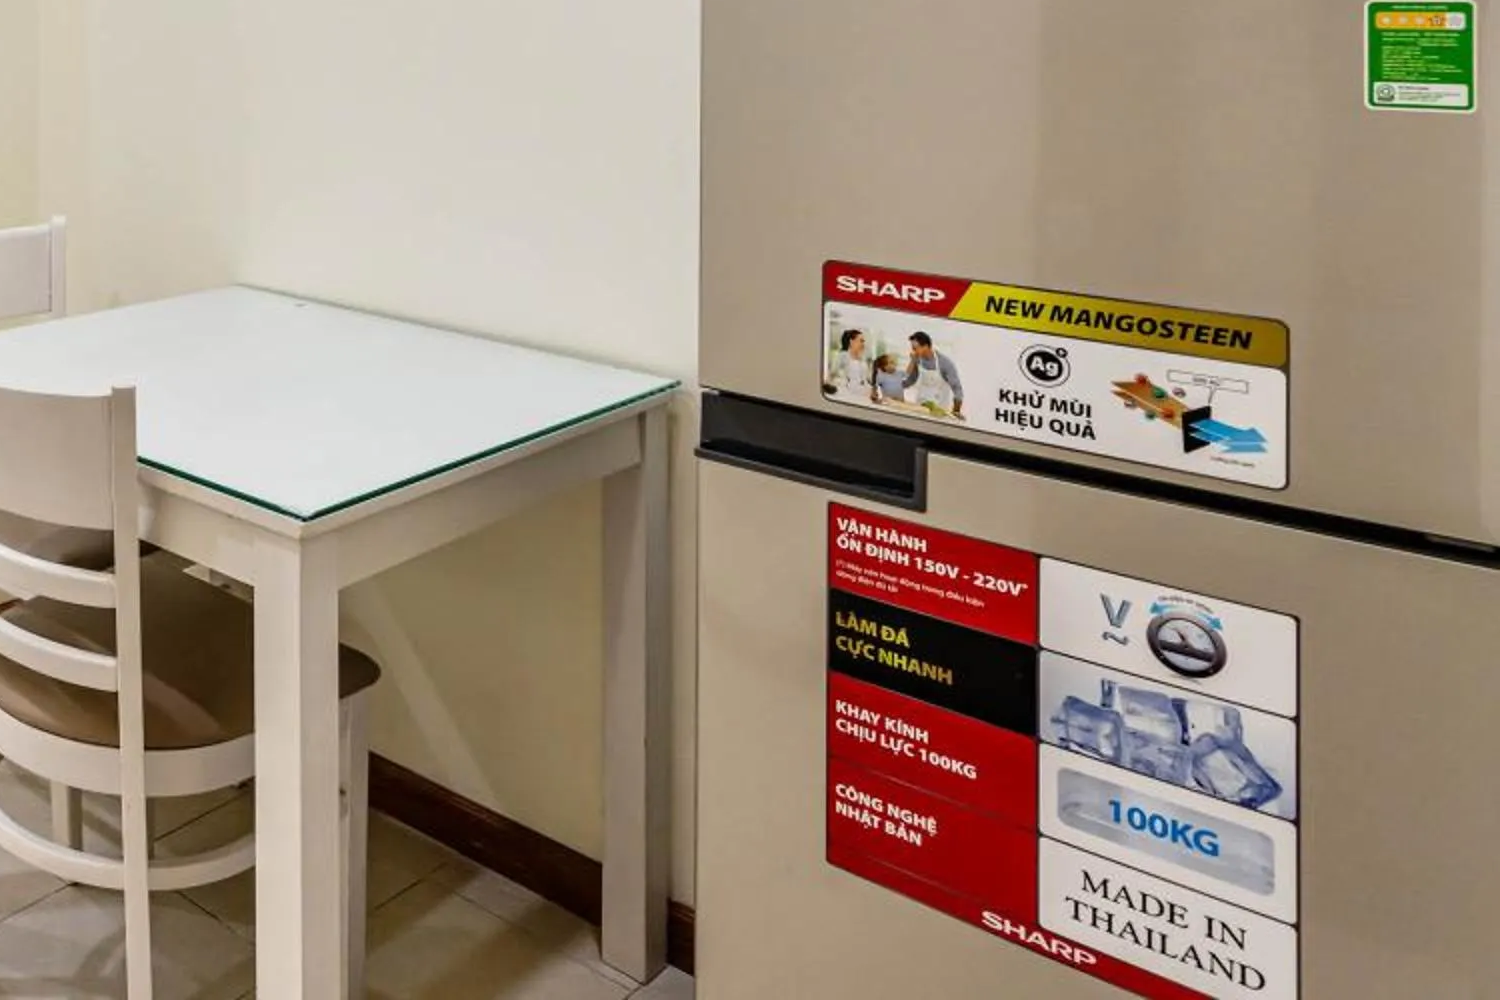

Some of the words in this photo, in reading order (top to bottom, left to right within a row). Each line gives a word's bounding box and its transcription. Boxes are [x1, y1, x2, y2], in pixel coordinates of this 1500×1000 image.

[836, 275, 946, 304] SHARP
[985, 295, 1044, 321] NEW
[1049, 304, 1253, 351] MANGOSTEEN
[994, 408, 1043, 431] HIỆU
[1049, 418, 1097, 441] QUẢ
[998, 388, 1046, 410] KHỬ
[1049, 397, 1092, 419] MÙI
[865, 542, 910, 567] ĐỊNH
[914, 557, 960, 580] 150V
[875, 527, 928, 553] HÀNH
[835, 610, 877, 638] LÀM
[881, 624, 910, 649] ĐÁ
[835, 635, 876, 661] CỰC
[878, 647, 954, 686] NHANH
[835, 699, 881, 727] KHAY
[884, 716, 930, 744] KÍNH
[835, 717, 877, 743] CHỊU
[880, 733, 915, 757] LỰC
[918, 747, 978, 780] 100KG
[835, 783, 884, 813] CÔNG
[887, 803, 938, 837] NGHỆ
[1108, 798, 1220, 857] 100KG
[1080, 868, 1190, 929] MADE
[1203, 914, 1248, 951] IN
[981, 910, 1098, 966] SHARP
[1065, 895, 1266, 992] THAILAND
